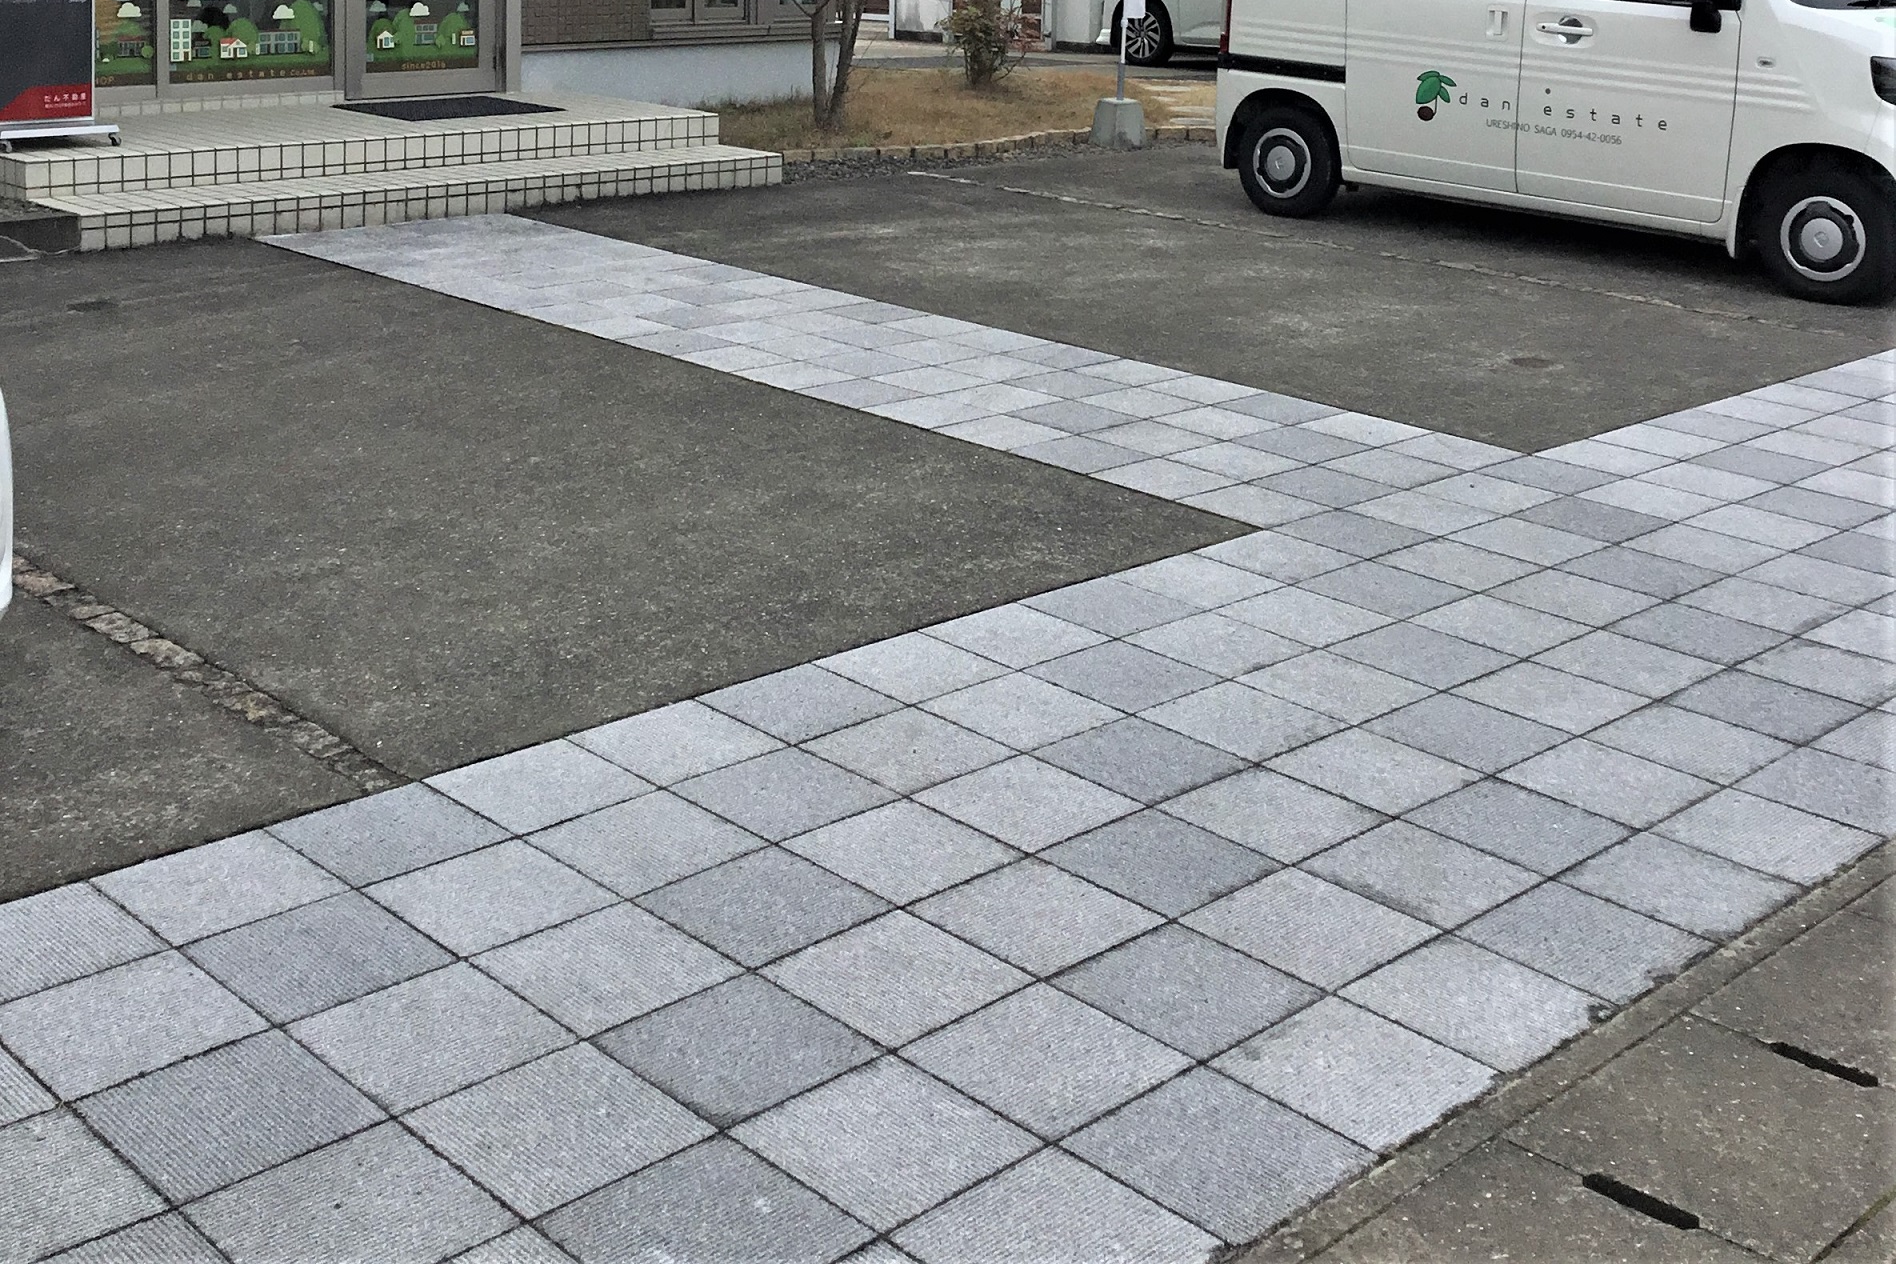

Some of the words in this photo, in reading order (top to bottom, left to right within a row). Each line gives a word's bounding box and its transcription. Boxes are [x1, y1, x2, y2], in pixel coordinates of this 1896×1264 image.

[1458, 92, 1511, 111] dan
[1543, 105, 1668, 131] estate
[1534, 124, 1557, 137] SAGA
